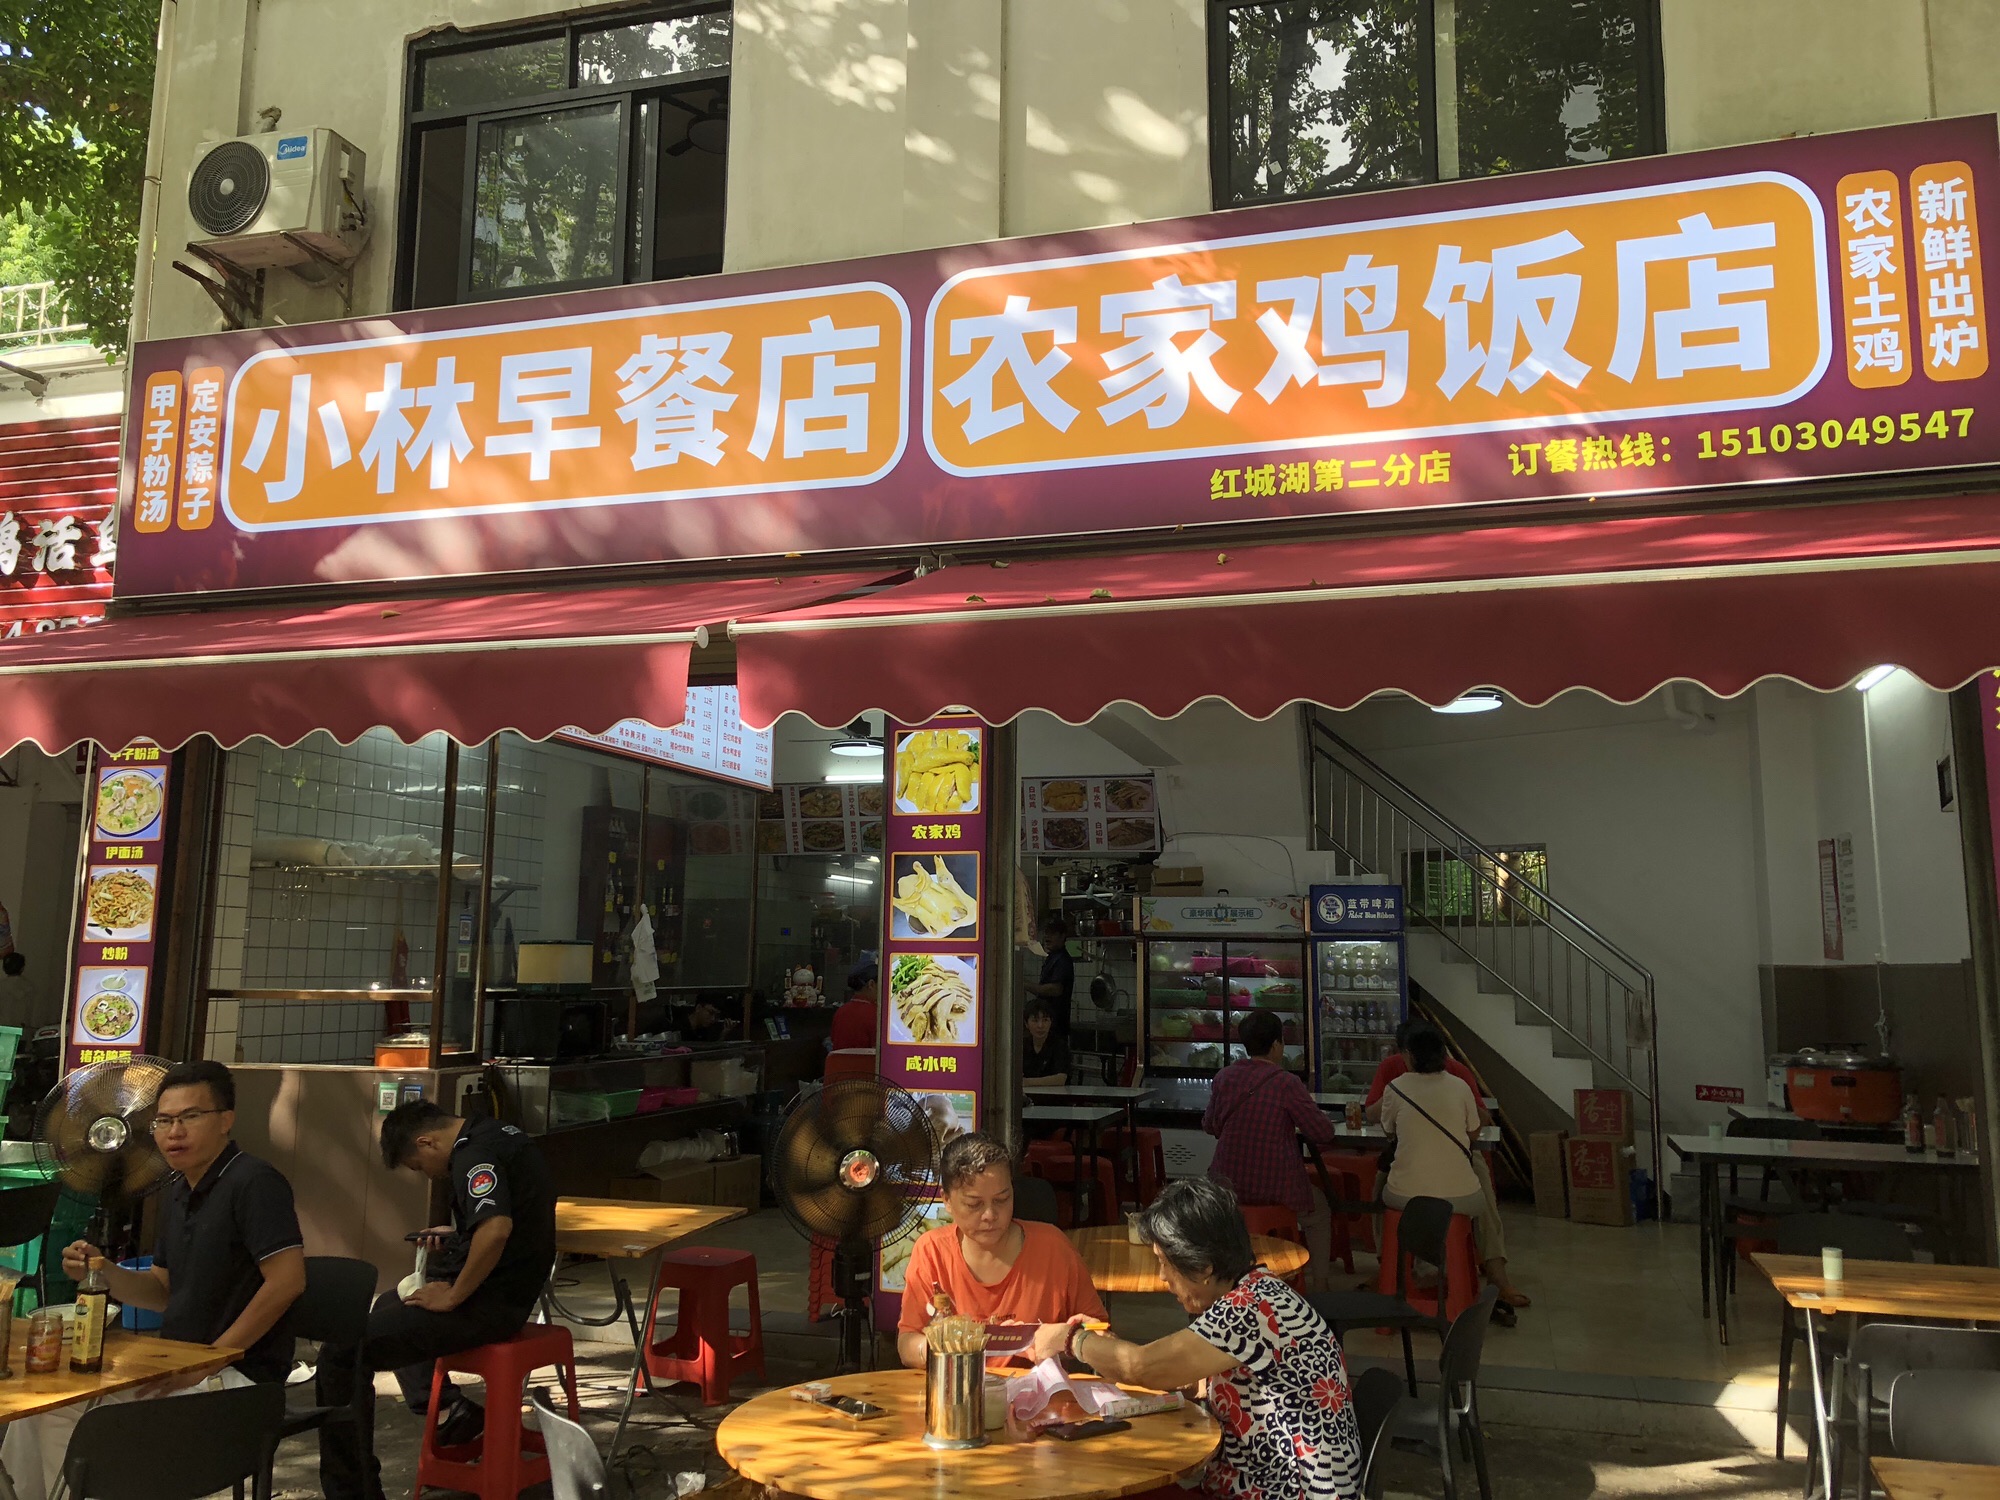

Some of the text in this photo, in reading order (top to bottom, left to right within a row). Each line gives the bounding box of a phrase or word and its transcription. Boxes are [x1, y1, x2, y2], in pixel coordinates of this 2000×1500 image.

[281, 144, 305, 154] Midea
[1845, 187, 1904, 374] 农家土鸡
[1918, 176, 1980, 368] 新鲜出炉
[938, 212, 1777, 445] 农家鸡饭店
[241, 315, 880, 504] 小林早餐店
[139, 384, 176, 523] 甲子粉汤
[182, 378, 220, 521] 定安粽子
[1508, 407, 1975, 480] 订餐热线： 15103049547
[1210, 449, 1451, 501] 红城湖第二分店
[105, 846, 144, 859] 伊面汤
[911, 823, 962, 840] 农家鸡
[1347, 898, 1395, 910] 蓝带啤酒
[102, 946, 128, 960] 炒粉
[905, 1055, 958, 1073] 咸水鸭
